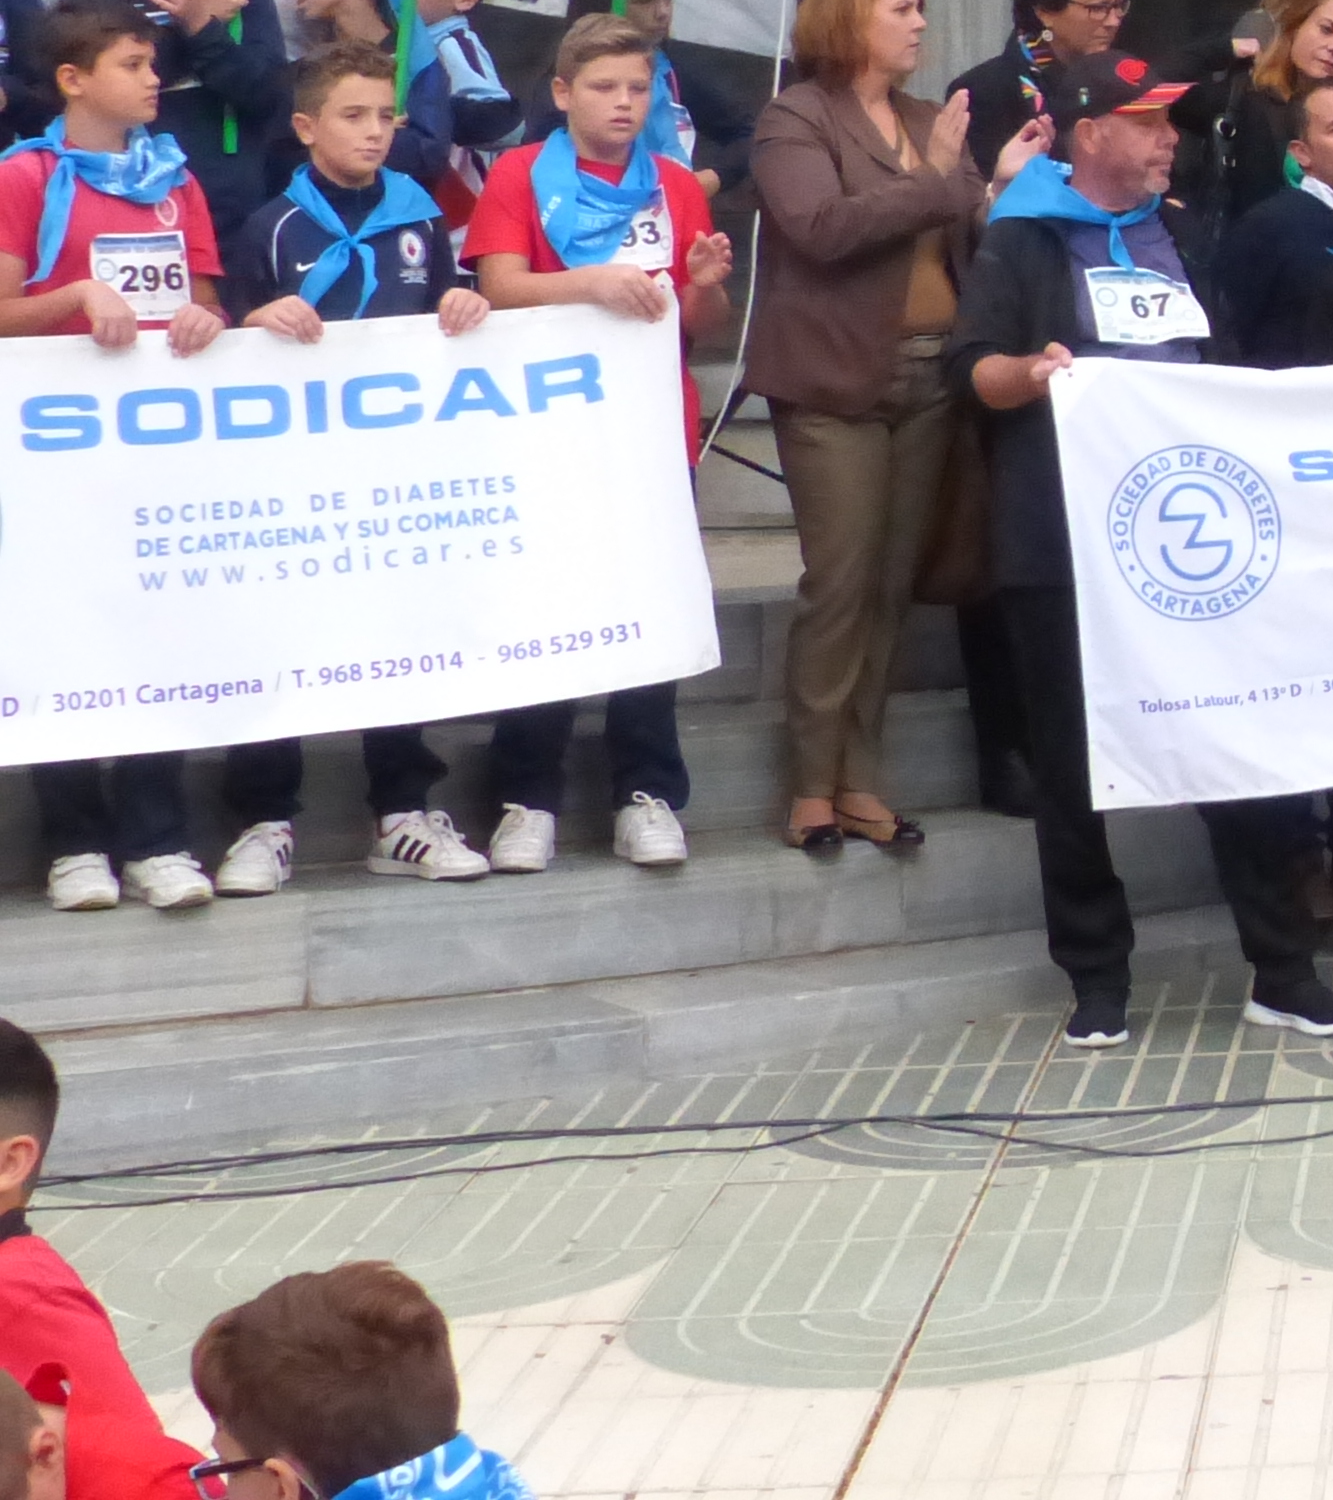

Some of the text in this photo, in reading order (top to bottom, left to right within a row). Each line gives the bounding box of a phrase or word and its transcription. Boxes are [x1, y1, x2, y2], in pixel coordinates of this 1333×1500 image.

[119, 263, 184, 292] 296
[1131, 292, 1171, 319] 67
[20, 352, 605, 452] SODICAR
[135, 475, 516, 526] SOCIEDAD DE DIABETES
[1112, 451, 1275, 551] SOCIEDAD DE DIABETES
[136, 505, 519, 558] DE CARTAGENA Y SU COMARCA
[139, 535, 524, 591] www.sodicar.es
[1141, 573, 1262, 616] CARTAGENA
[1, 697, 19, 717] D
[52, 687, 126, 712] 30201
[136, 679, 263, 704] Cartagena
[292, 669, 313, 689] T.
[319, 663, 363, 685] 968
[370, 657, 413, 679] 529
[420, 651, 463, 674] 014
[497, 639, 543, 663] 968
[549, 630, 593, 655] 529
[600, 621, 642, 646] 931
[1139, 698, 1191, 713] Tolosa
[1194, 692, 1244, 708] Latour,
[1248, 690, 1257, 702] 4
[1290, 683, 1302, 697] D
